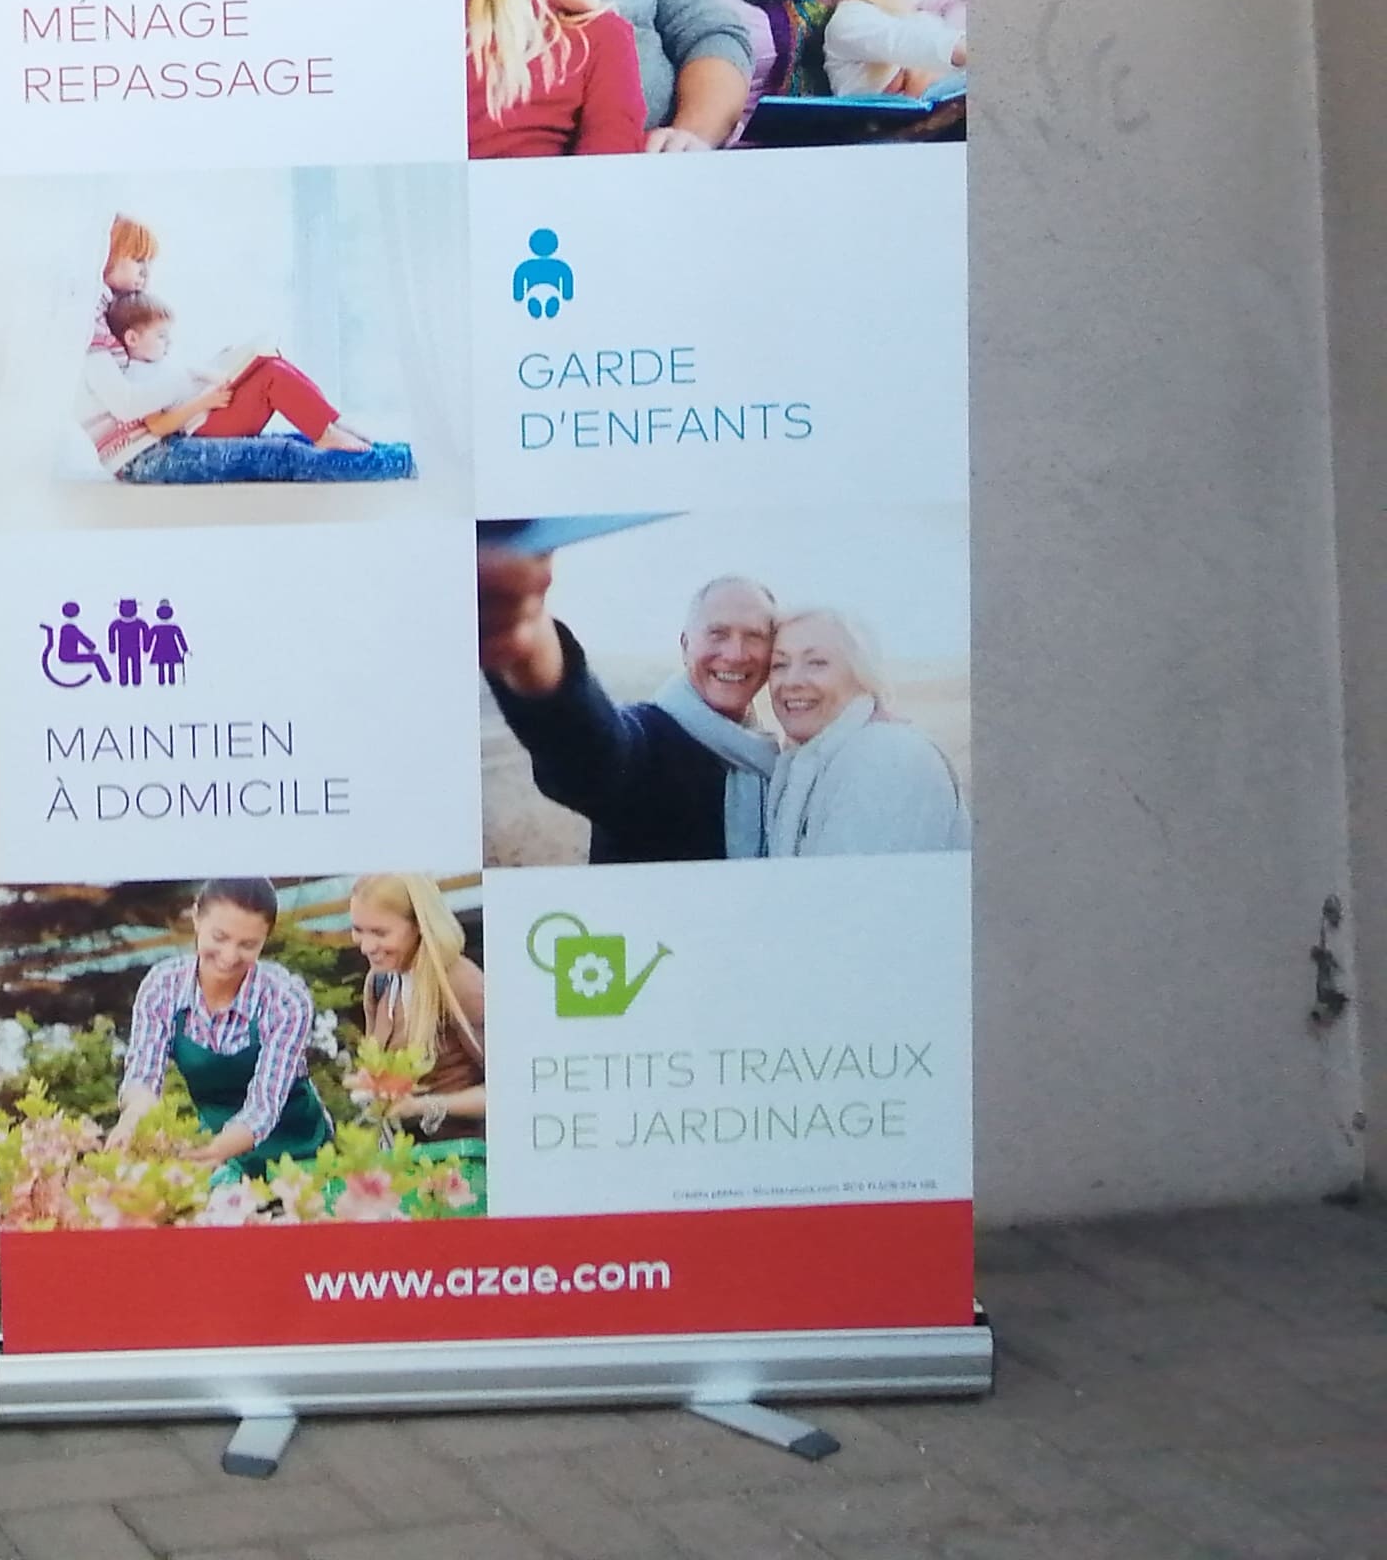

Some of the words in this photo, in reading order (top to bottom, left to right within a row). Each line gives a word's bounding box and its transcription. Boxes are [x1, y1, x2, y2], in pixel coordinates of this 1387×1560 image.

[25, 58, 333, 102] REPASSAGE
[519, 348, 695, 389] GARDE
[522, 403, 812, 449] D'ENFANTS
[47, 721, 292, 762] MAINTIEN
[47, 777, 78, 821] À
[97, 779, 350, 819] DOMICILE
[531, 1052, 694, 1093] PETITS
[709, 1042, 933, 1085] TRAVAUX
[533, 1114, 597, 1150] DE
[616, 1101, 906, 1145] JARDINAGE
[305, 1259, 671, 1300] www.azae.com
